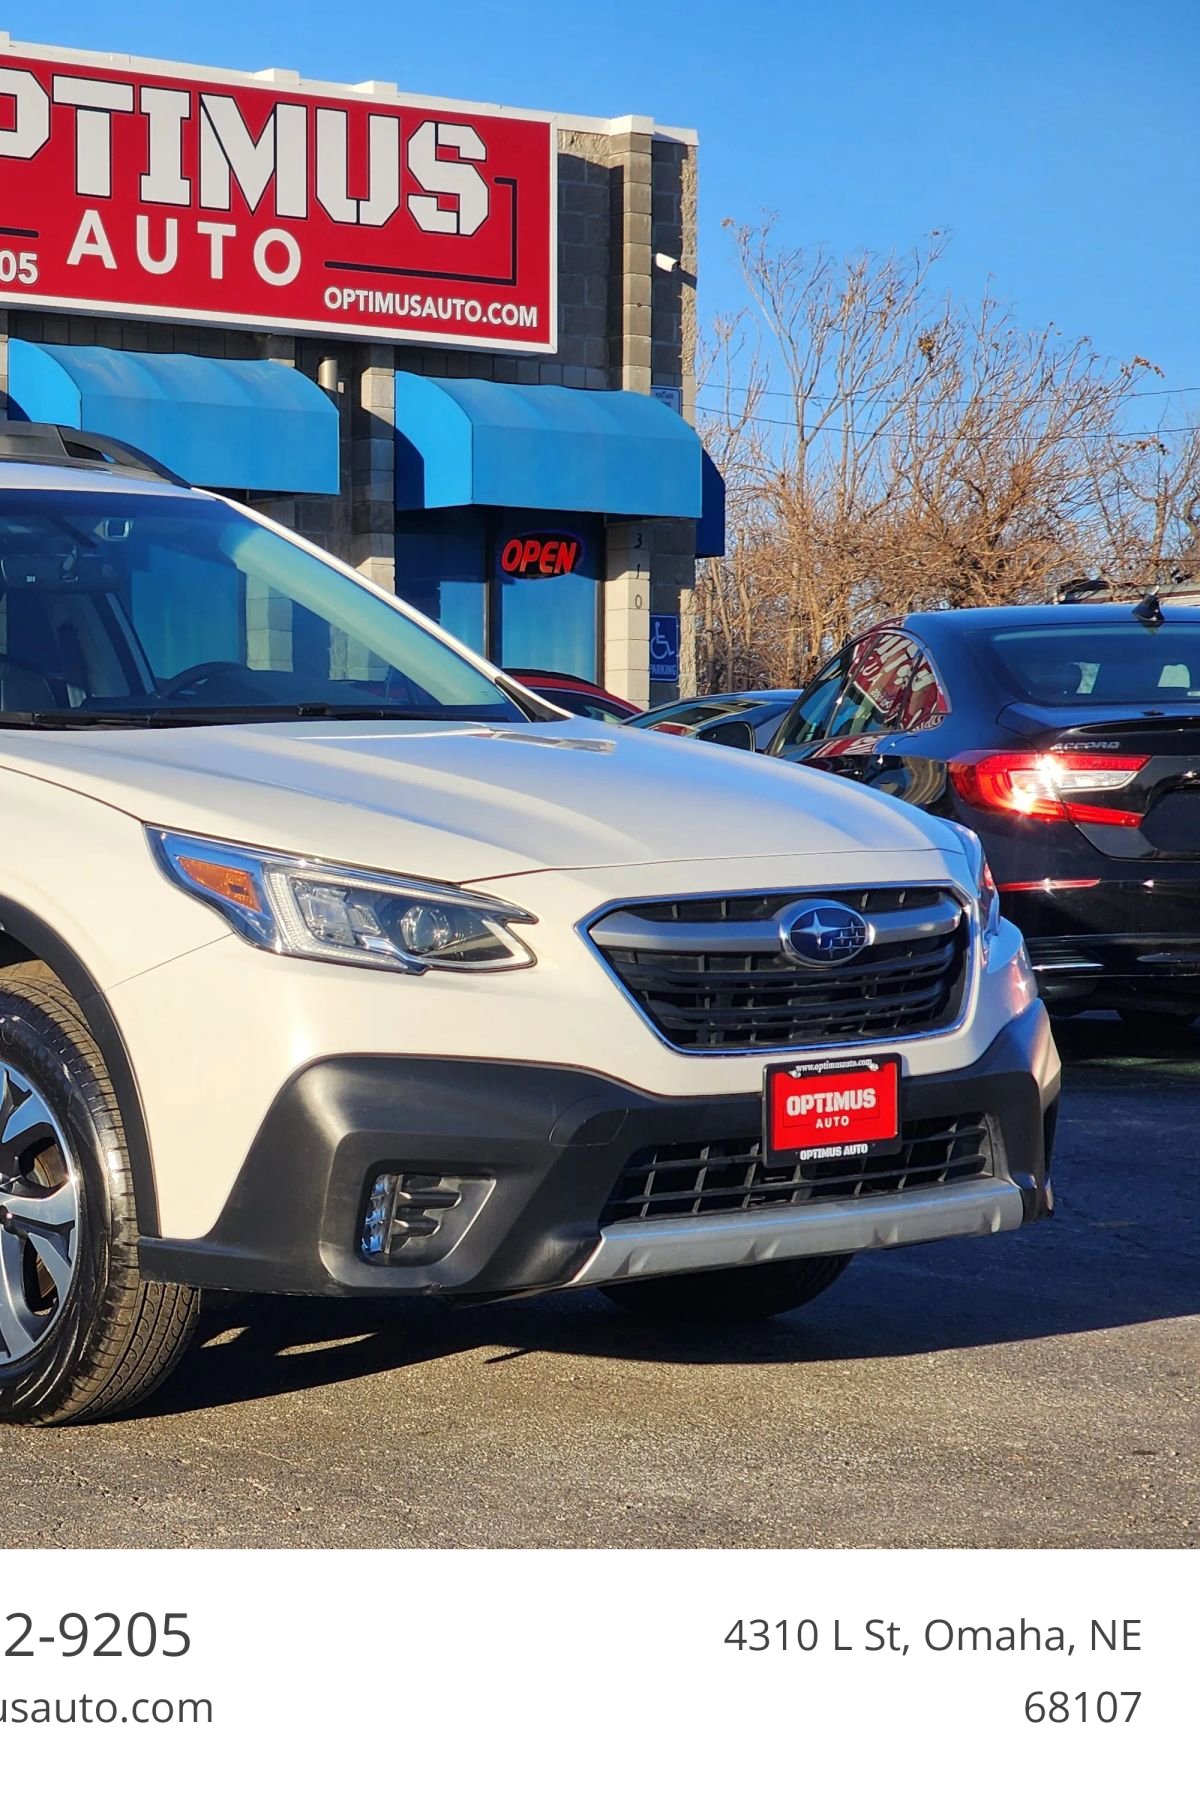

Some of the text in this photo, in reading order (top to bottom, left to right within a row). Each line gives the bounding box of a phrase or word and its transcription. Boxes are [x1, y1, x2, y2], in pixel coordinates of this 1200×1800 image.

[66, 209, 301, 286] AUTO
[323, 286, 538, 328] OPTIMUSAUTO.COM
[501, 539, 577, 574] OPEN
[795, 1058, 872, 1073] www.optimusauto.com
[786, 1088, 876, 1116] OPTIMUS
[815, 1115, 850, 1129] AUTO
[800, 1143, 868, 1161] OPTIMUS AUTO
